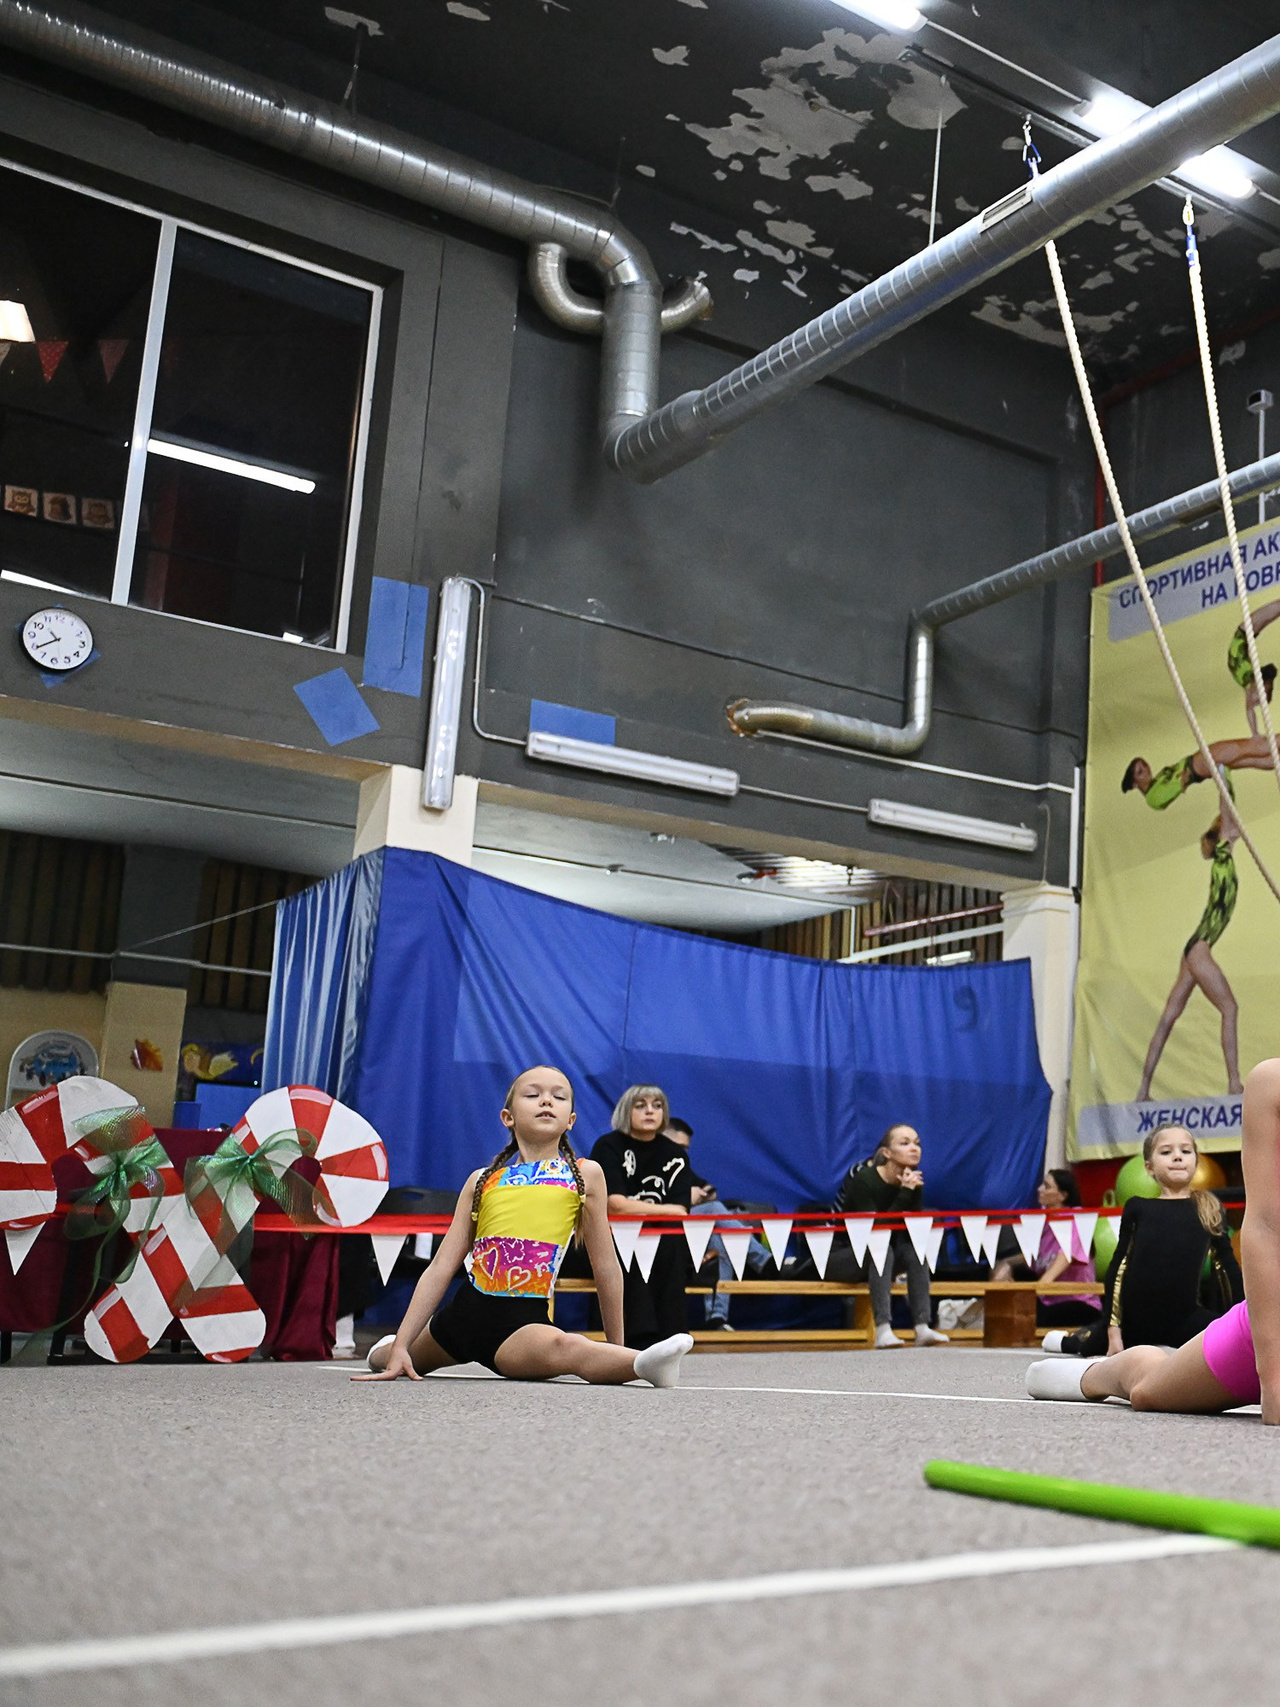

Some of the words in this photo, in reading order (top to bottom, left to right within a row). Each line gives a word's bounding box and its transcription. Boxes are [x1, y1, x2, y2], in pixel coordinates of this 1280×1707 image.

[1201, 581, 1228, 608] НА
[33, 621, 44, 630] 10
[1137, 1103, 1243, 1133] ЖЕНСКАЯ
